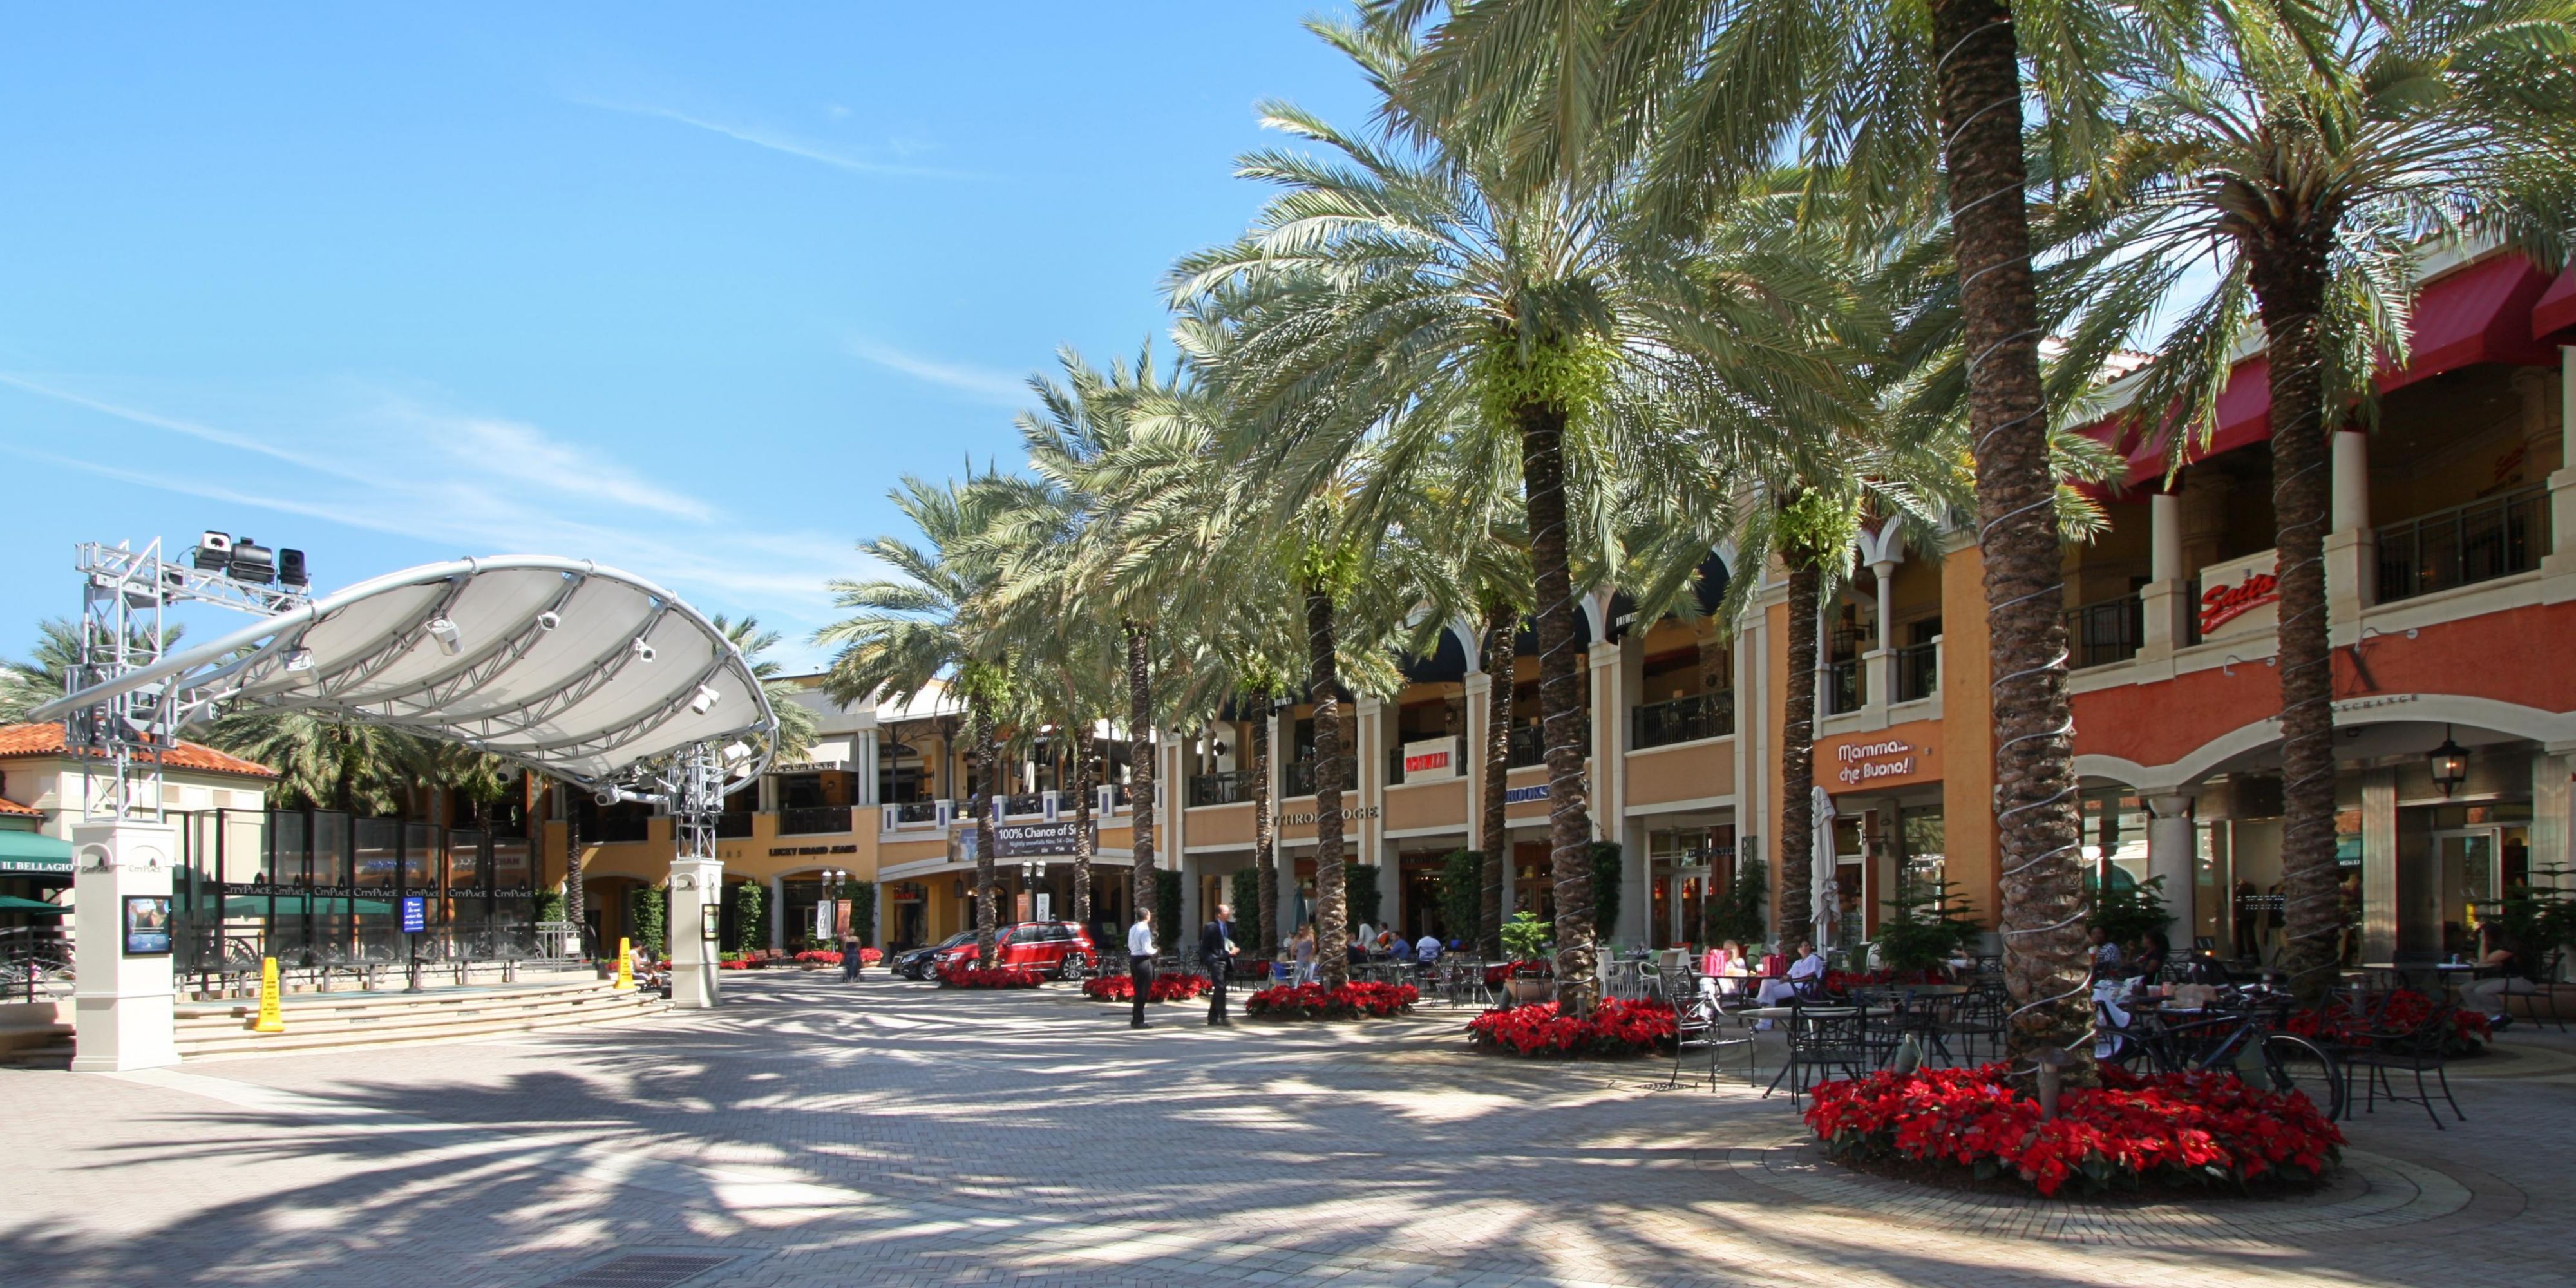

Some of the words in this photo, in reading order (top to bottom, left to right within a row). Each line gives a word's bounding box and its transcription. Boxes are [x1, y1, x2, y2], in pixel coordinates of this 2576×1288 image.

[2197, 573, 2278, 620] Saito
[1838, 741, 1908, 763] Mamma...
[1839, 766, 1861, 784] che
[1863, 757, 1909, 779] Buono!
[1504, 786, 1549, 803] ROOKS
[998, 828, 1023, 840] 100%
[1024, 826, 1056, 838] Chance
[1057, 824, 1067, 835] of
[3, 861, 15, 869] IL
[17, 862, 74, 872] BELLAGIO
